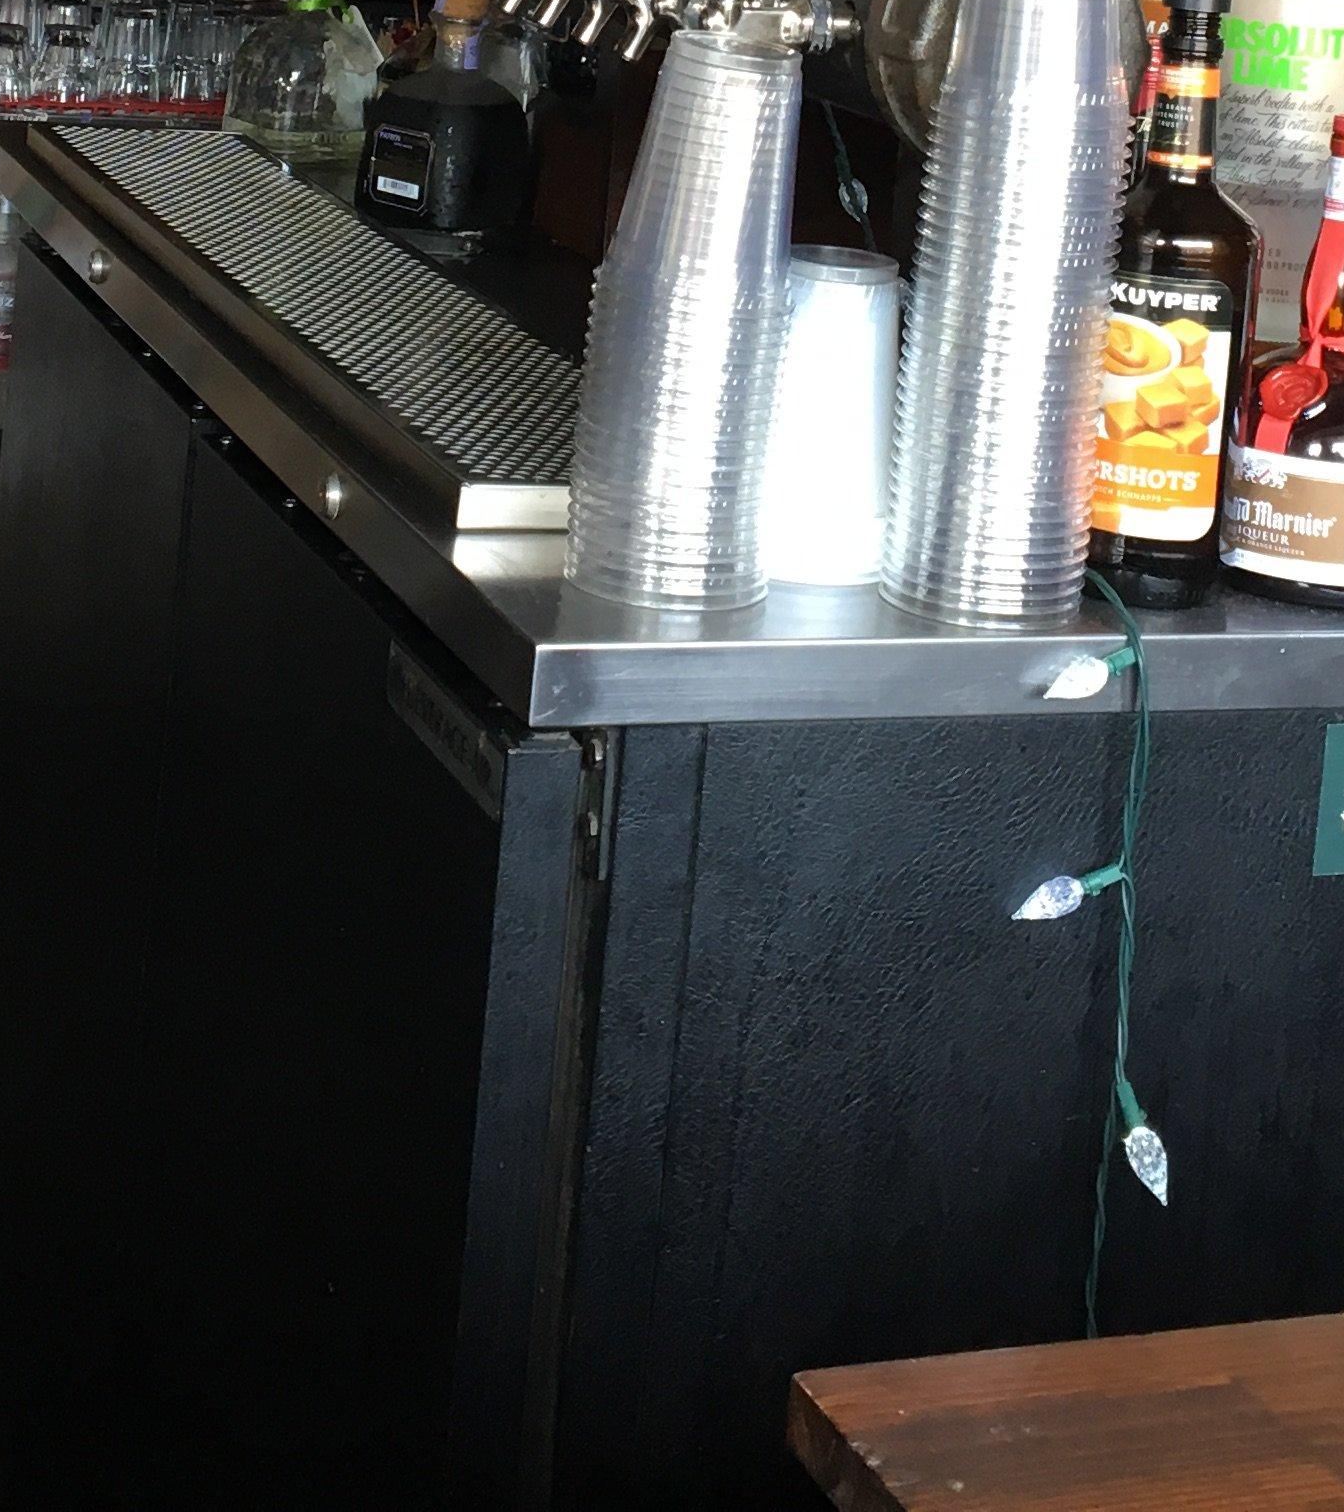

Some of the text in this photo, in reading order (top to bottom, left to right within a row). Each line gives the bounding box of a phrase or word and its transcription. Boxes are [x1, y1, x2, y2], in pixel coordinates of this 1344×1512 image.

[1232, 58, 1309, 91] LIME
[1109, 281, 1218, 312] KUYPER
[1251, 499, 1333, 539] Marnier
